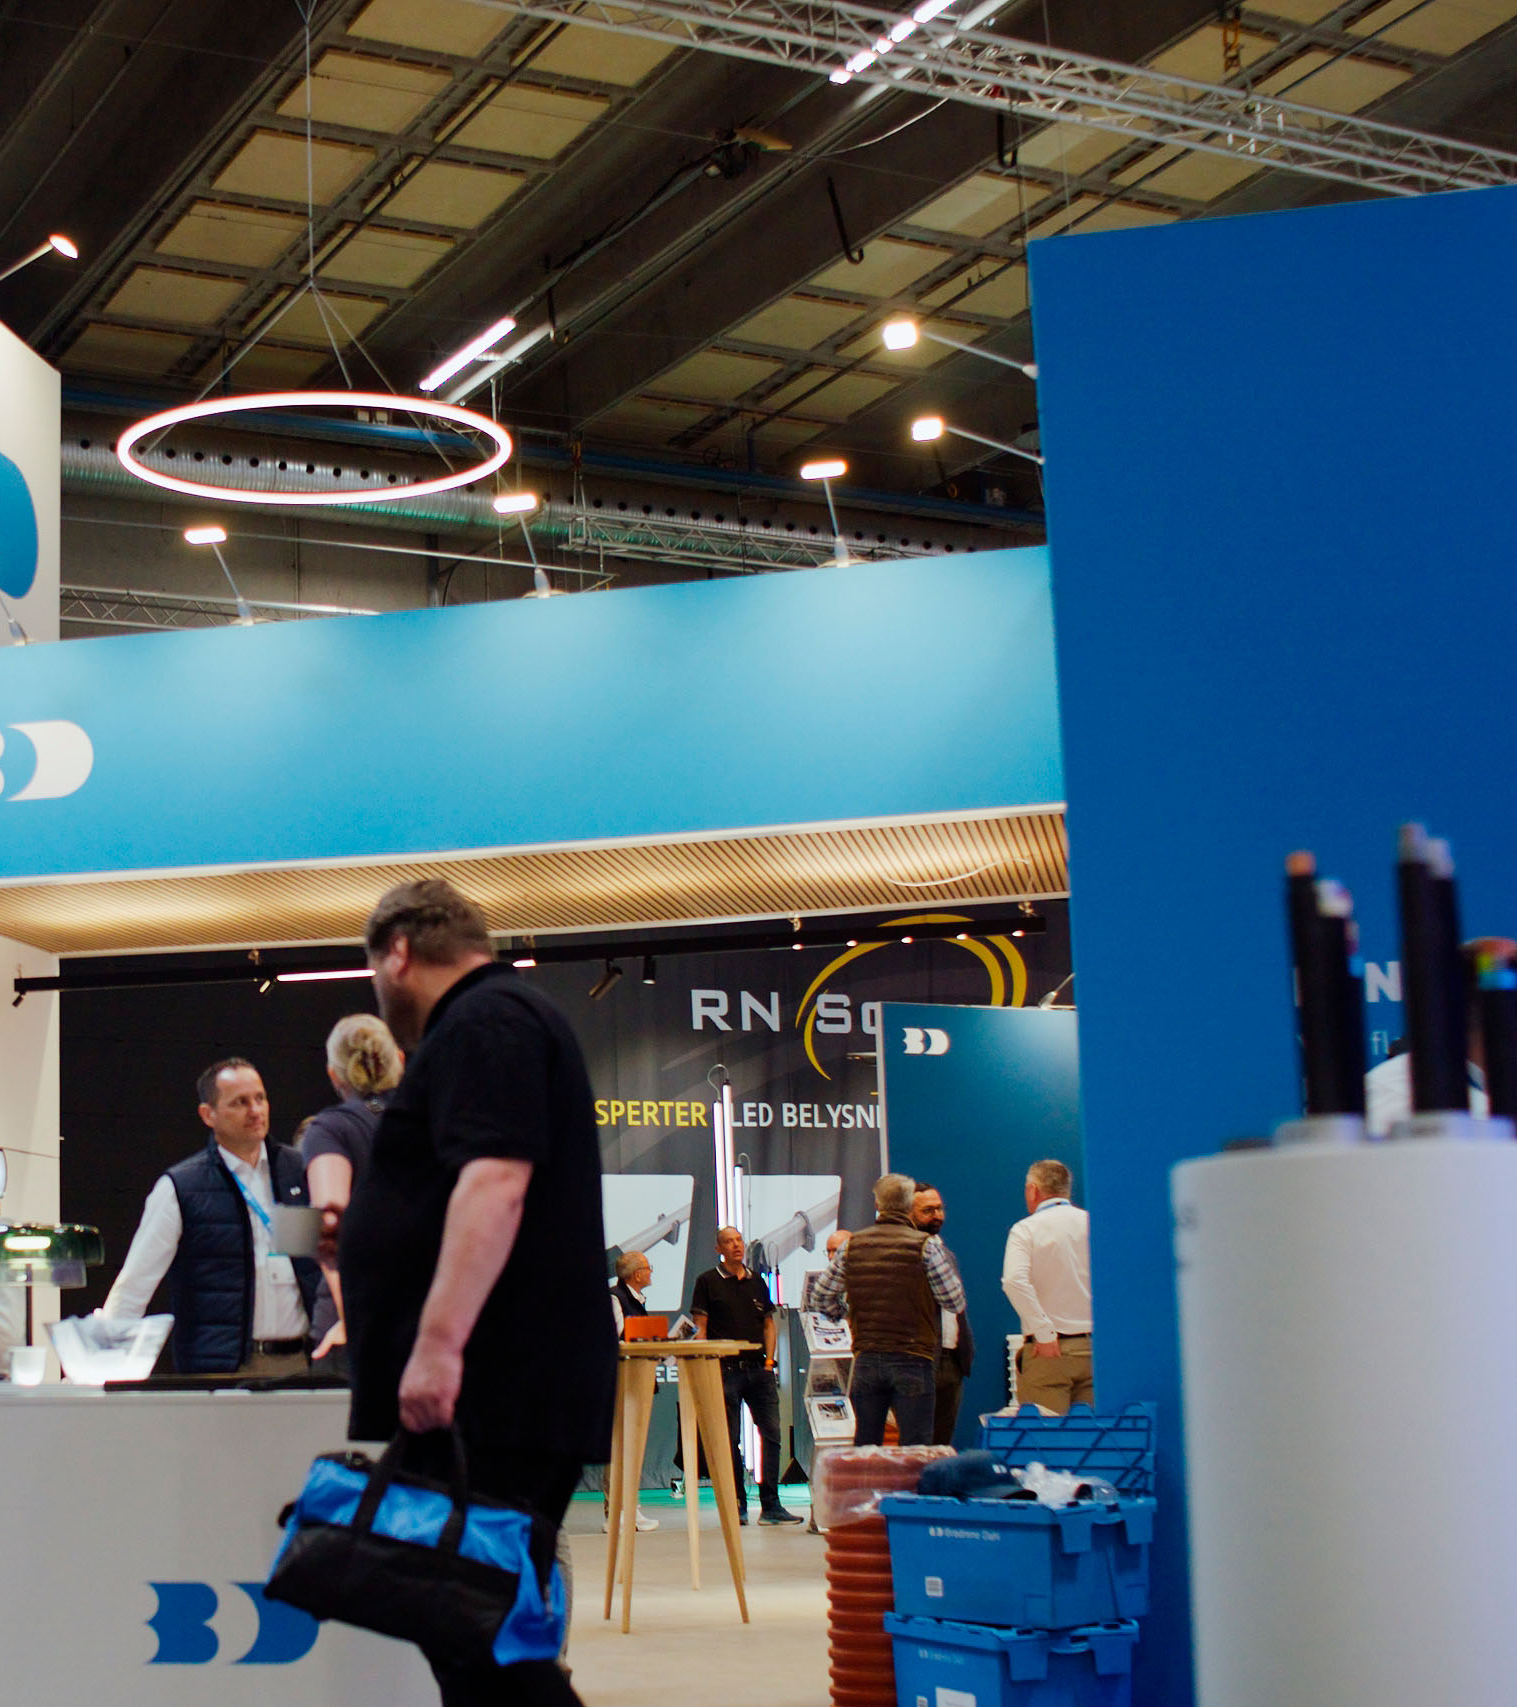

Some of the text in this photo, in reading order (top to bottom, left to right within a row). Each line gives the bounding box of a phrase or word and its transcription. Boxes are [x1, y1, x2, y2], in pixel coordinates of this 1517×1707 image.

[690, 988, 781, 1032] RN
[902, 1027, 950, 1055] BD
[593, 1098, 708, 1127] SPERTER
[729, 1101, 774, 1128] LED
[146, 1581, 320, 1665] BD
